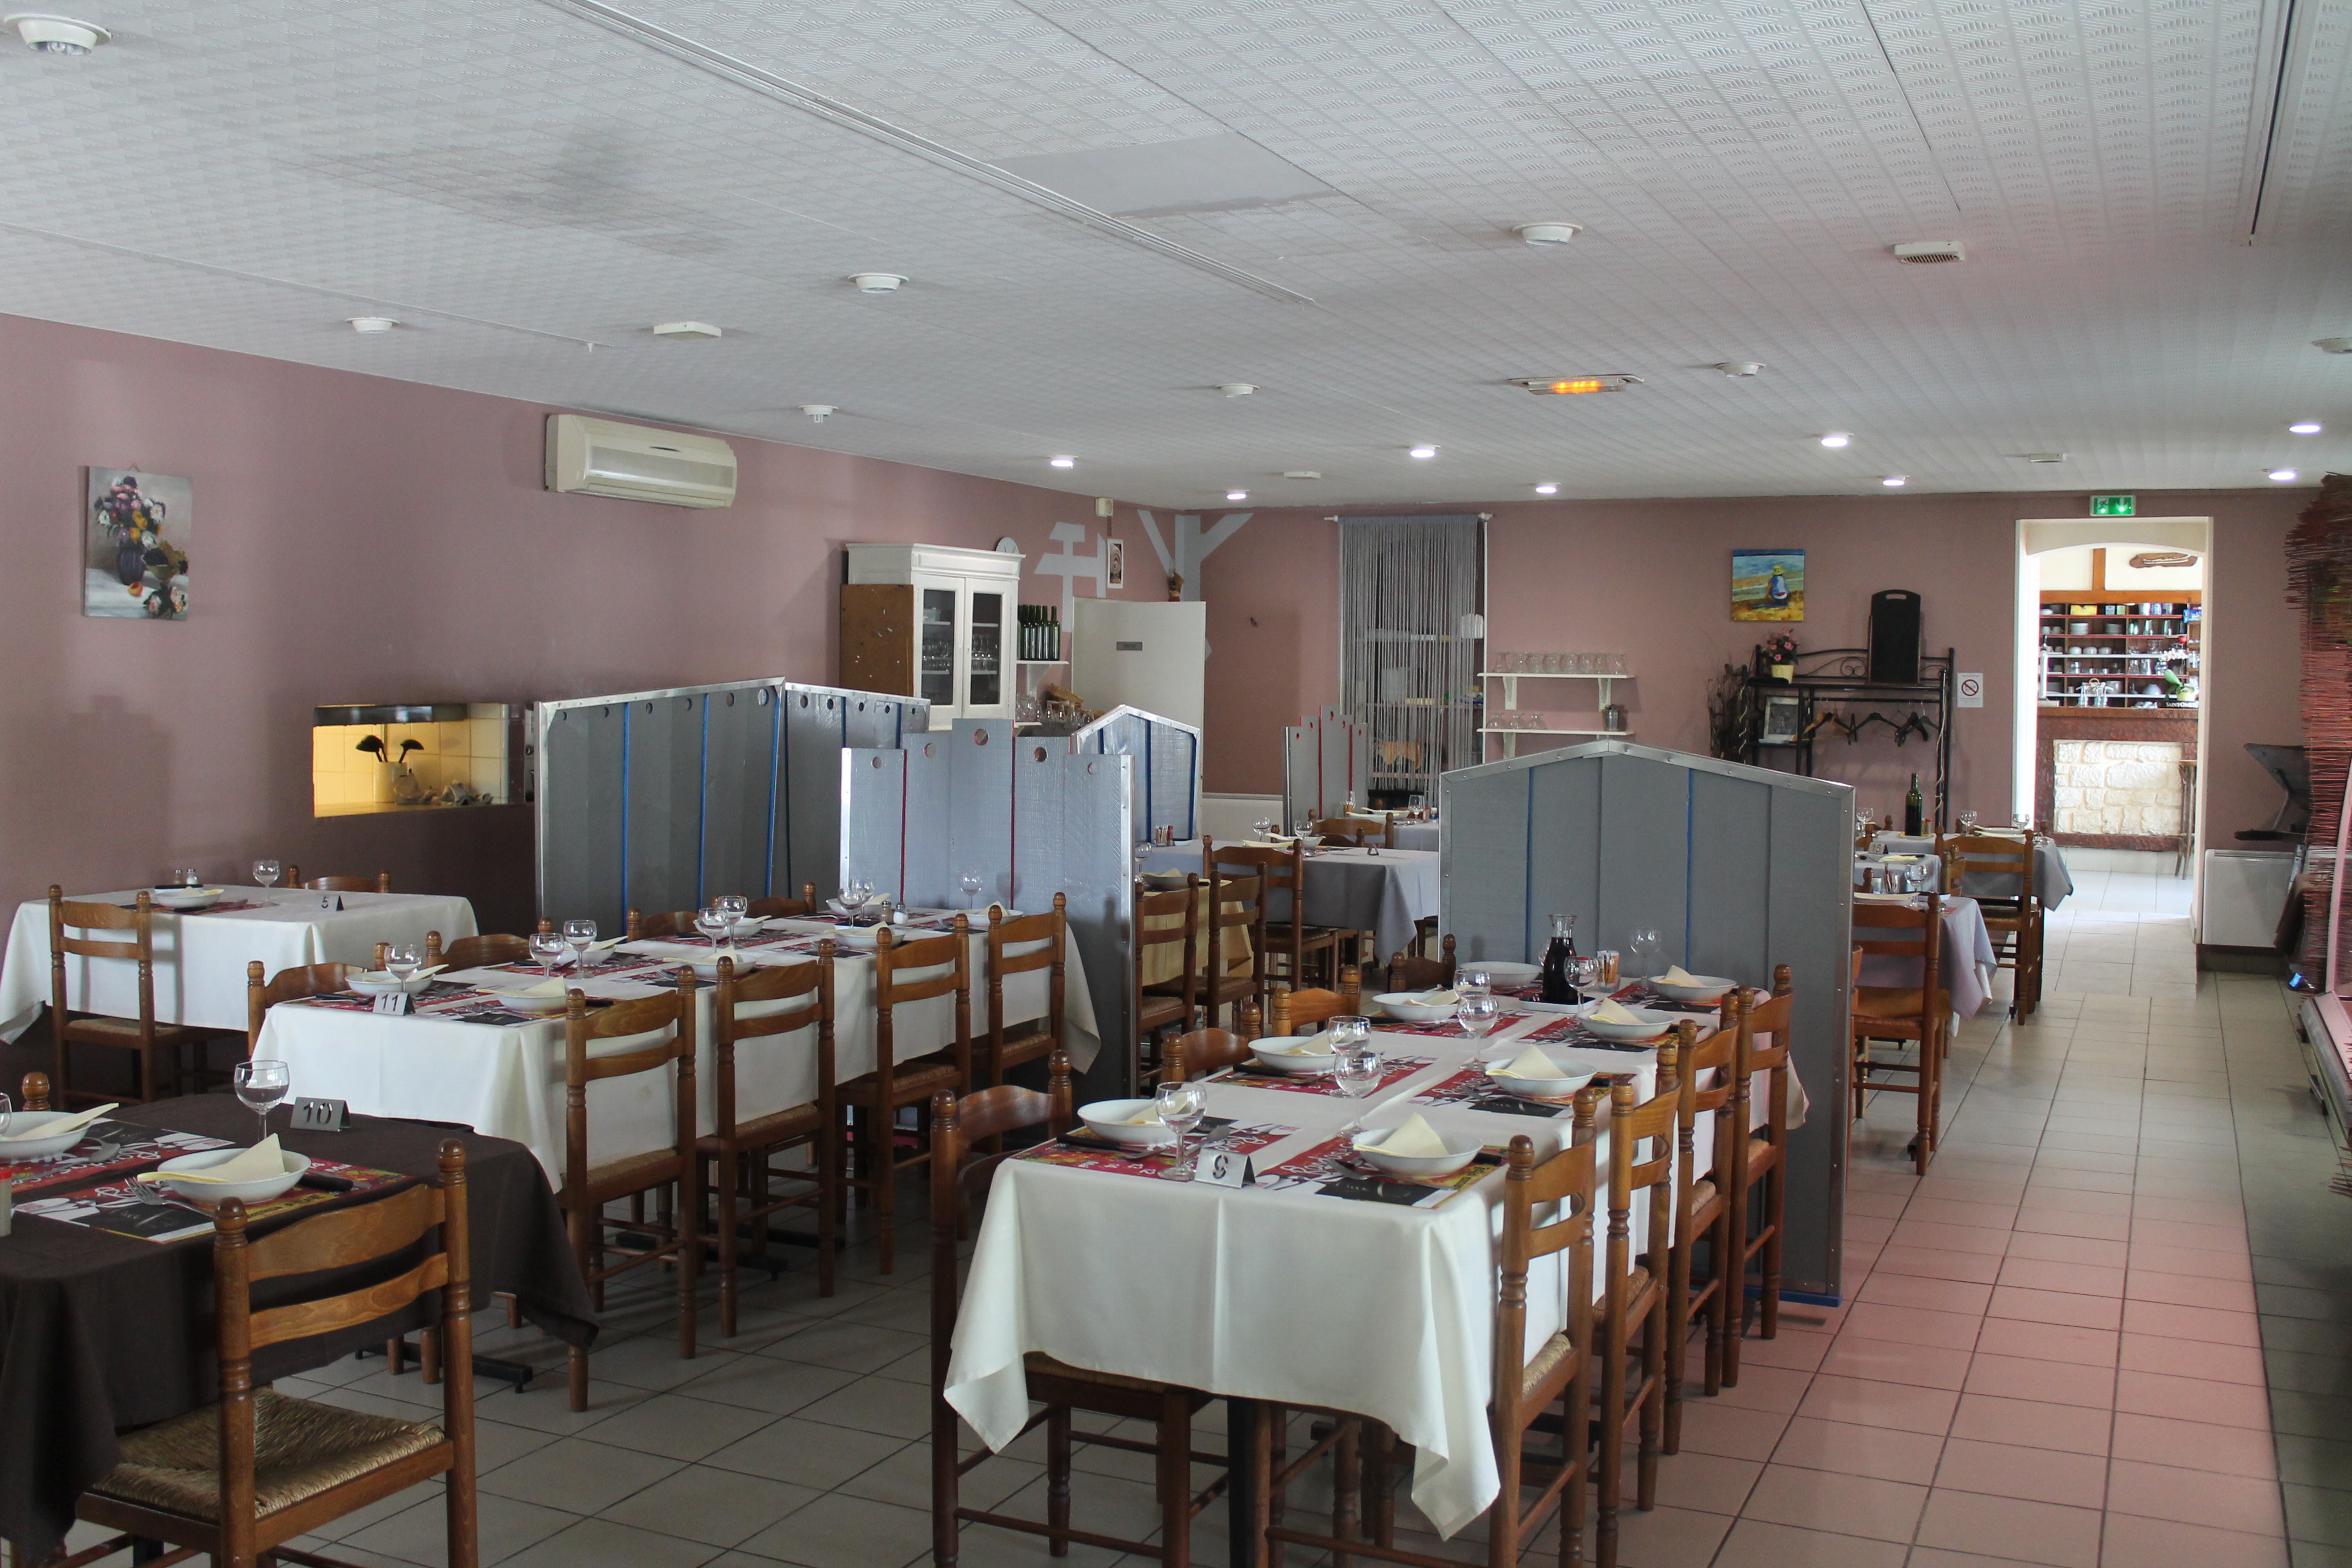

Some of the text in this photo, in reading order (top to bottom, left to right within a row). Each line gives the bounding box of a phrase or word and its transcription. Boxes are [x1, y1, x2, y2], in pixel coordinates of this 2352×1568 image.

[1871, 843, 1881, 853] 15
[322, 896, 329, 908] 5
[382, 993, 399, 1011] 11
[303, 1101, 333, 1124] 10
[1213, 1155, 1228, 1179] 9
